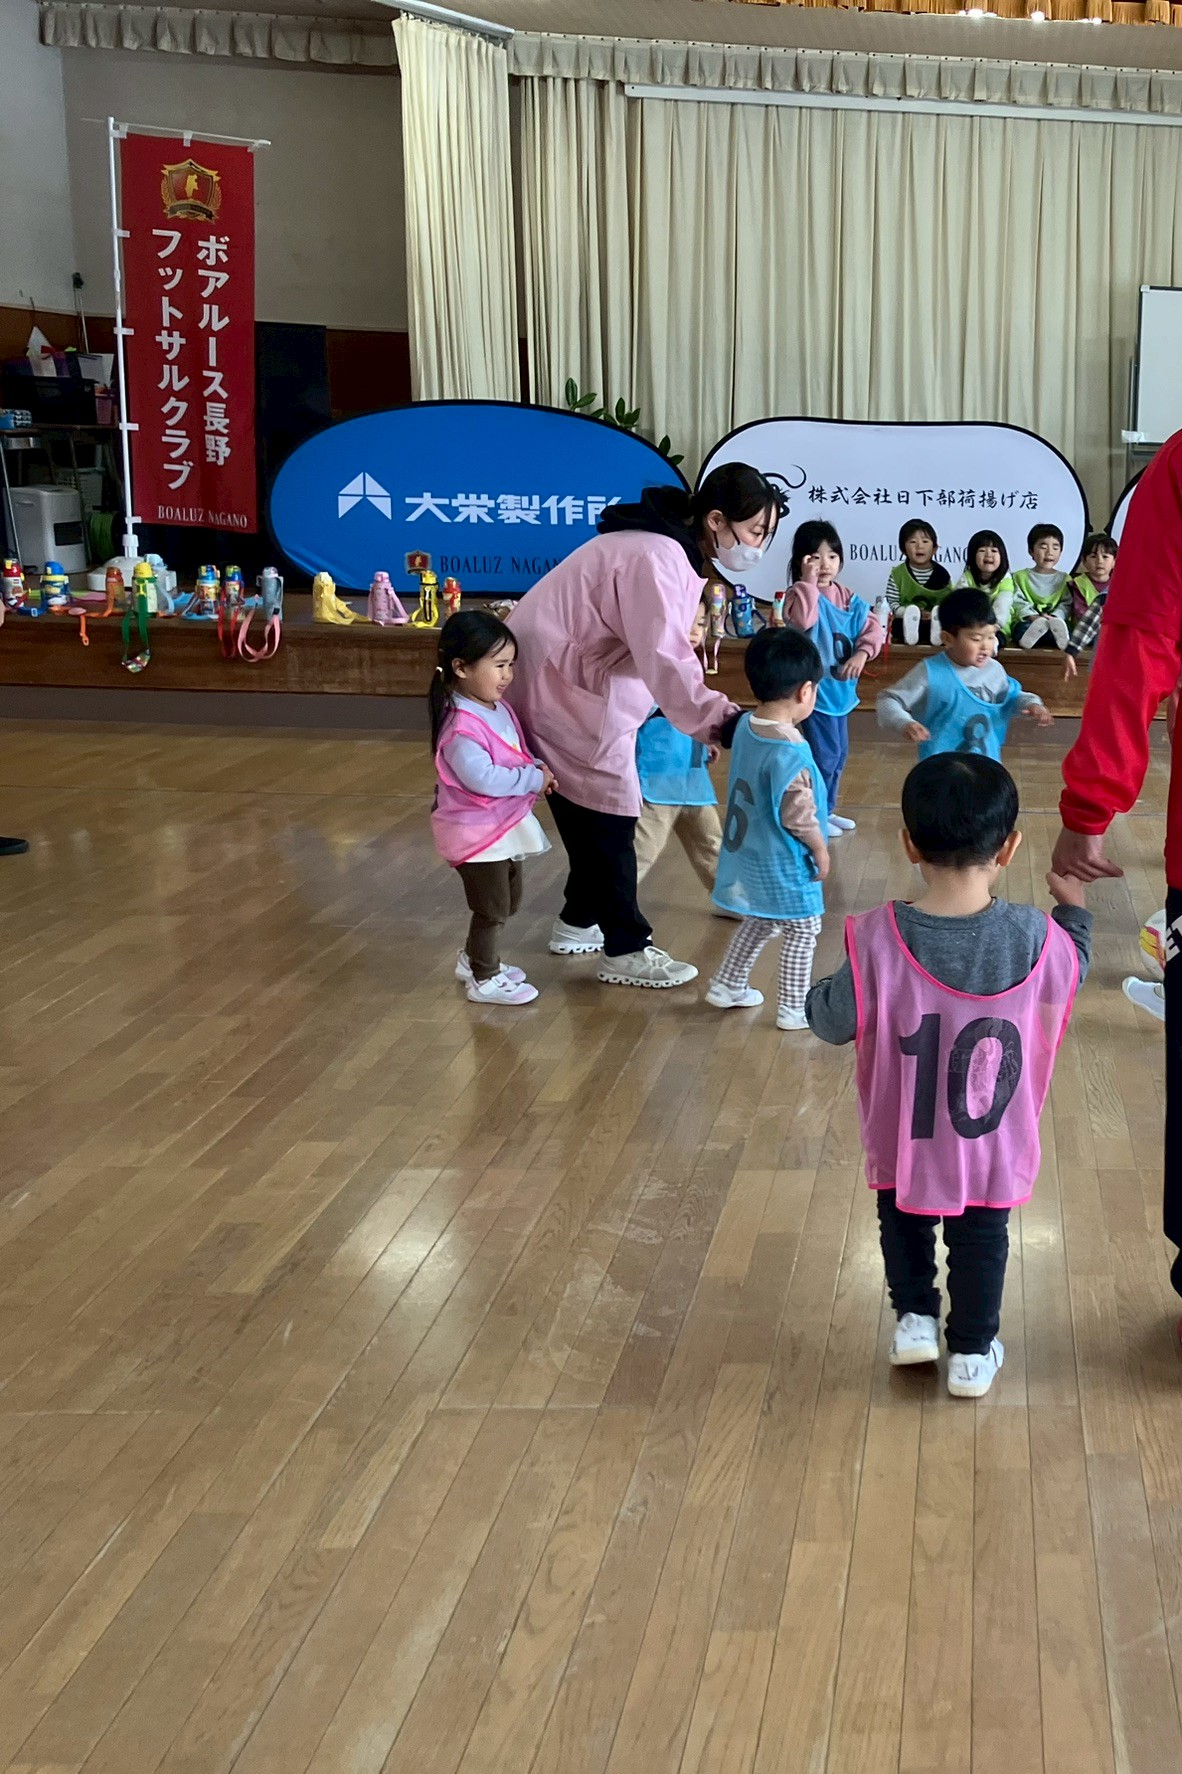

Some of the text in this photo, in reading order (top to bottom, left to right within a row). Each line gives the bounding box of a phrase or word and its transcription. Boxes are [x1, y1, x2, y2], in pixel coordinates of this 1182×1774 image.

[152, 228, 194, 490] フットサルクラブ
[197, 235, 231, 466] ボアルース長野
[158, 505, 248, 528] BOALUZ NAGANO
[808, 485, 1038, 510] 株式会社日下部荷揚げ店
[440, 555, 563, 574] BOALUZ NAGA
[934, 547, 969, 563] GAN
[723, 777, 755, 853] 6
[898, 1013, 1023, 1140] 10
